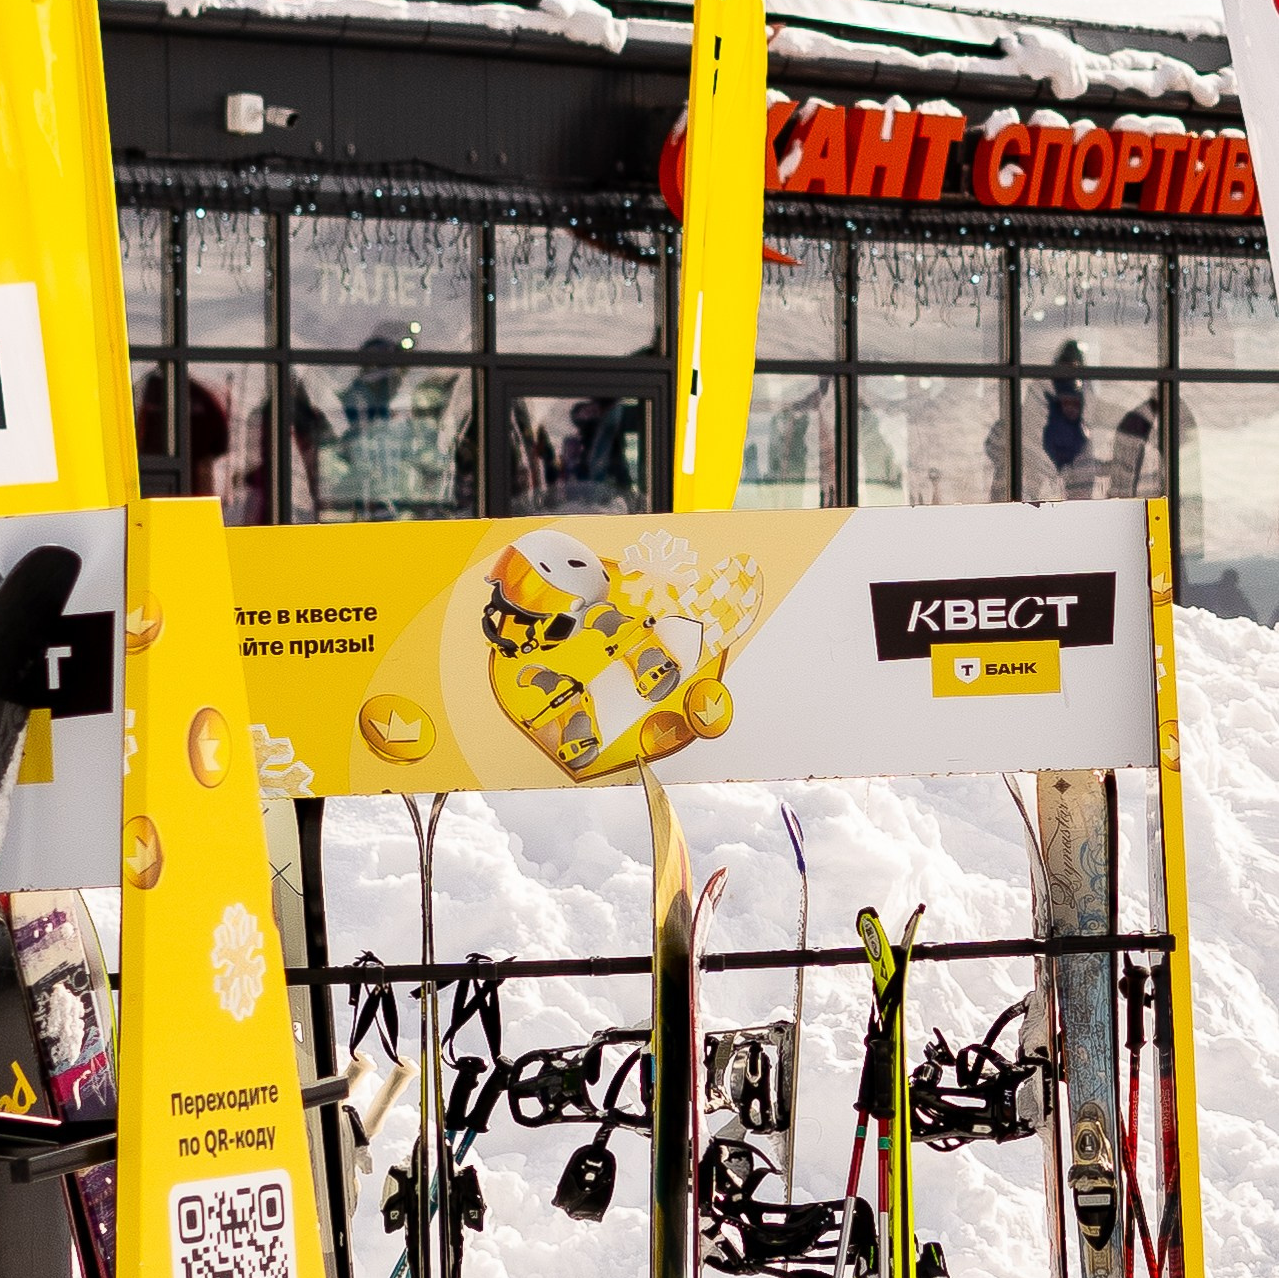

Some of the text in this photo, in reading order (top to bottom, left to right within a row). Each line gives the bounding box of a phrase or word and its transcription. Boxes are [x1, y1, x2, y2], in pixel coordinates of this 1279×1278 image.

[973, 121, 1268, 217] СПОРТИВ
[278, 609, 291, 624] в
[295, 603, 378, 624] квесте
[907, 595, 1079, 632] КВЕСТ
[289, 633, 375, 659] призы!
[961, 661, 1038, 677] Т БАНК
[1046, 802, 1083, 910] Dynastar
[171, 1083, 279, 1119] Переходите
[178, 1125, 277, 1158] по QR-коду
